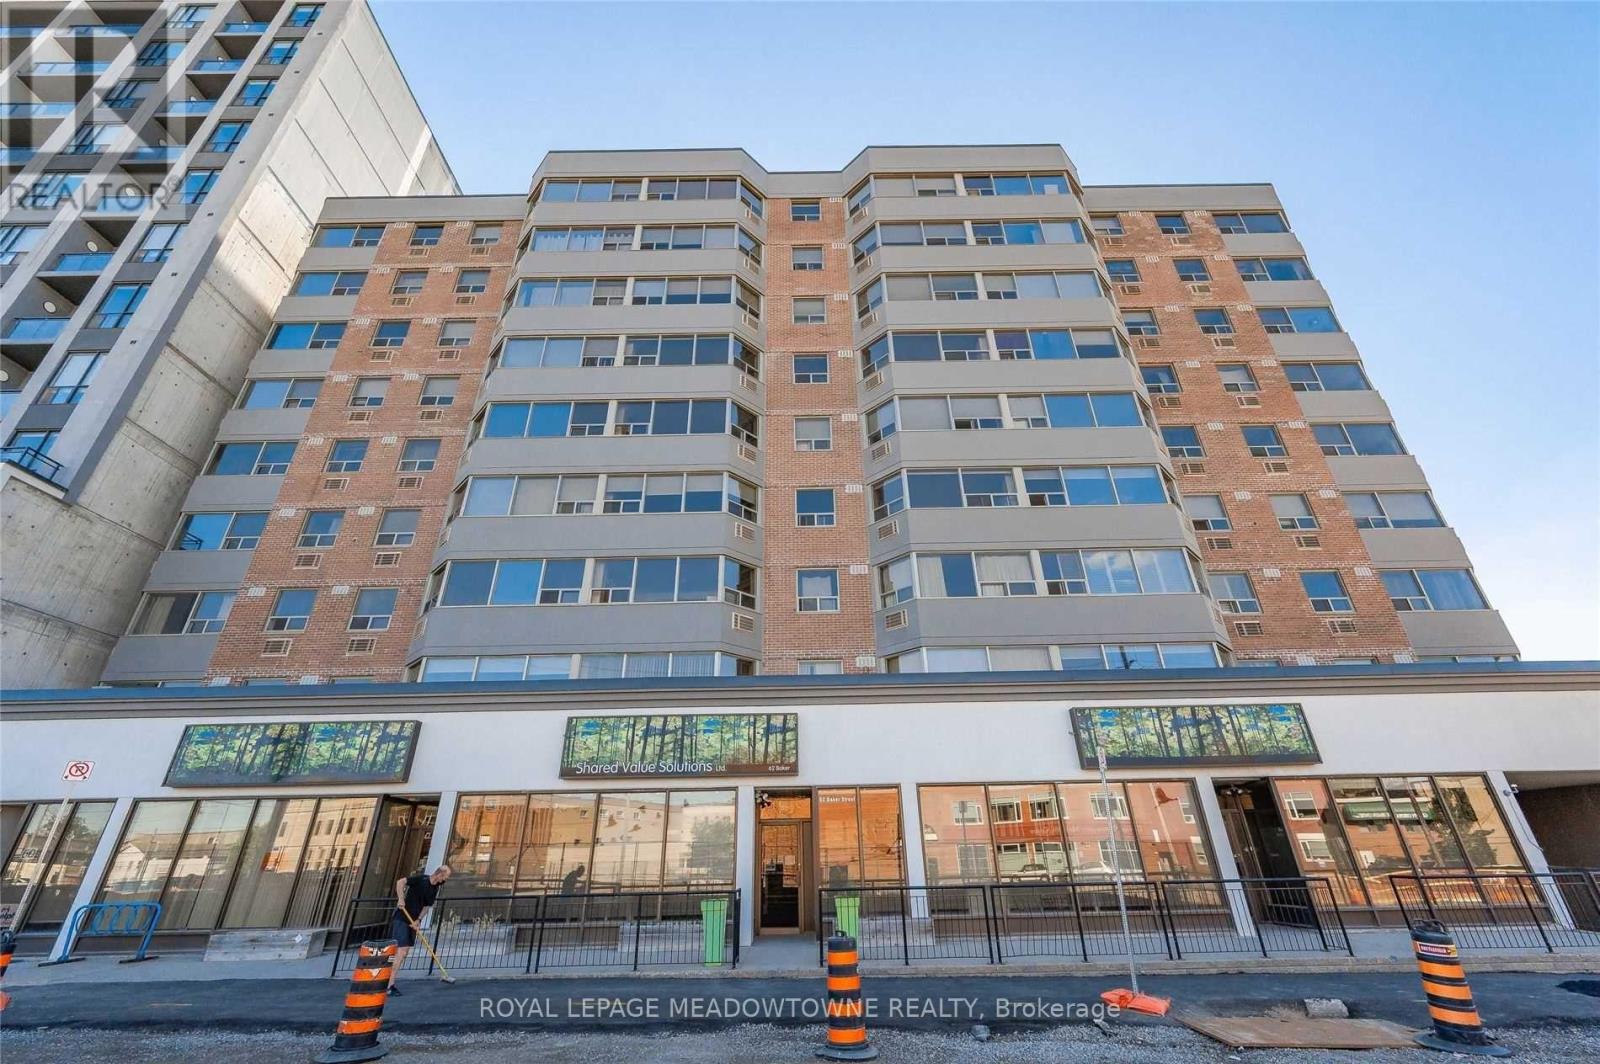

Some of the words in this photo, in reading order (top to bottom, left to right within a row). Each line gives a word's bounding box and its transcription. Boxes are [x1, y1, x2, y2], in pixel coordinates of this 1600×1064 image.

[575, 761, 619, 774] Shared
[622, 762, 656, 773] Value
[658, 760, 713, 773] Solutions
